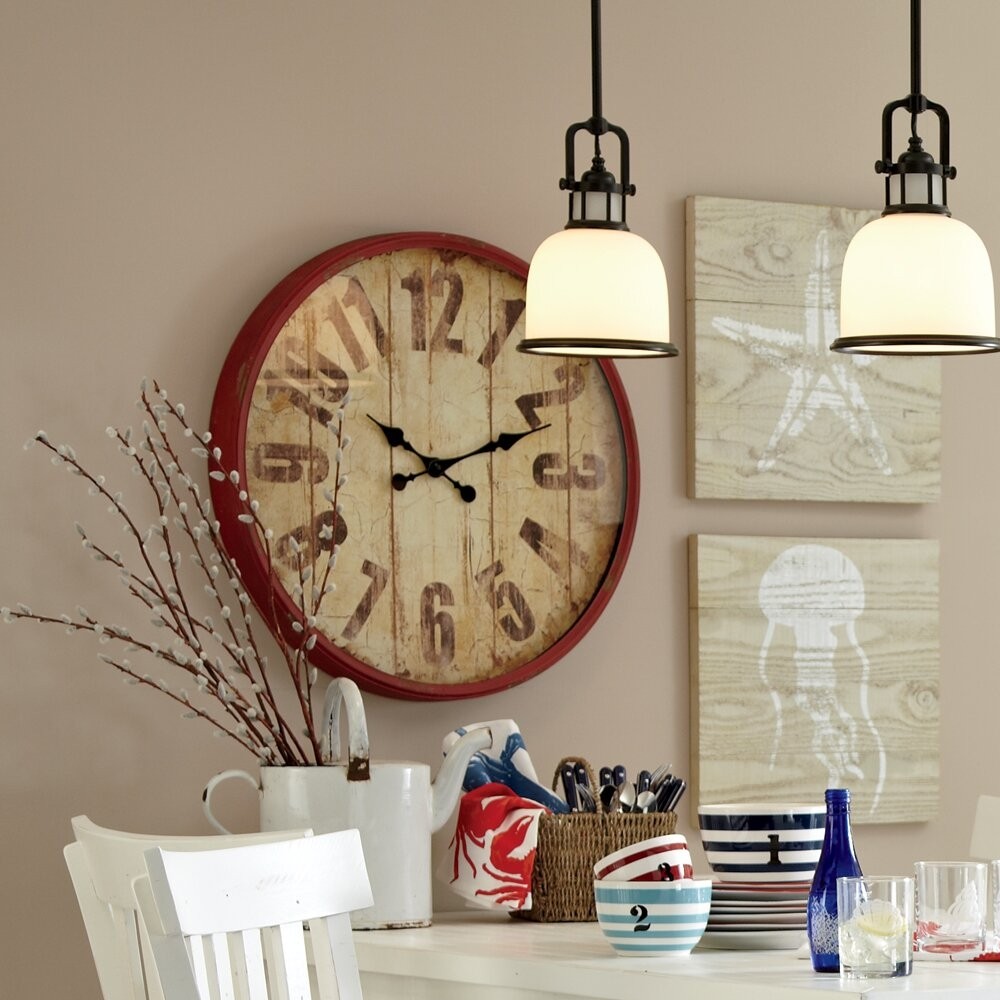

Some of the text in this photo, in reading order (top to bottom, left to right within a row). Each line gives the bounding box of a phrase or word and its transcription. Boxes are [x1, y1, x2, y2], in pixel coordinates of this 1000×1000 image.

[328, 275, 387, 373] 11
[401, 268, 464, 353] 12
[265, 336, 349, 427] 10
[515, 363, 586, 429] 2
[253, 441, 330, 485] 9
[532, 452, 606, 491] 3
[276, 510, 348, 572] 8
[519, 517, 591, 580] 4
[342, 559, 390, 641] 7
[419, 582, 456, 667] 6
[475, 560, 537, 642] 5
[767, 834, 782, 865] 1
[630, 904, 651, 932] 2
